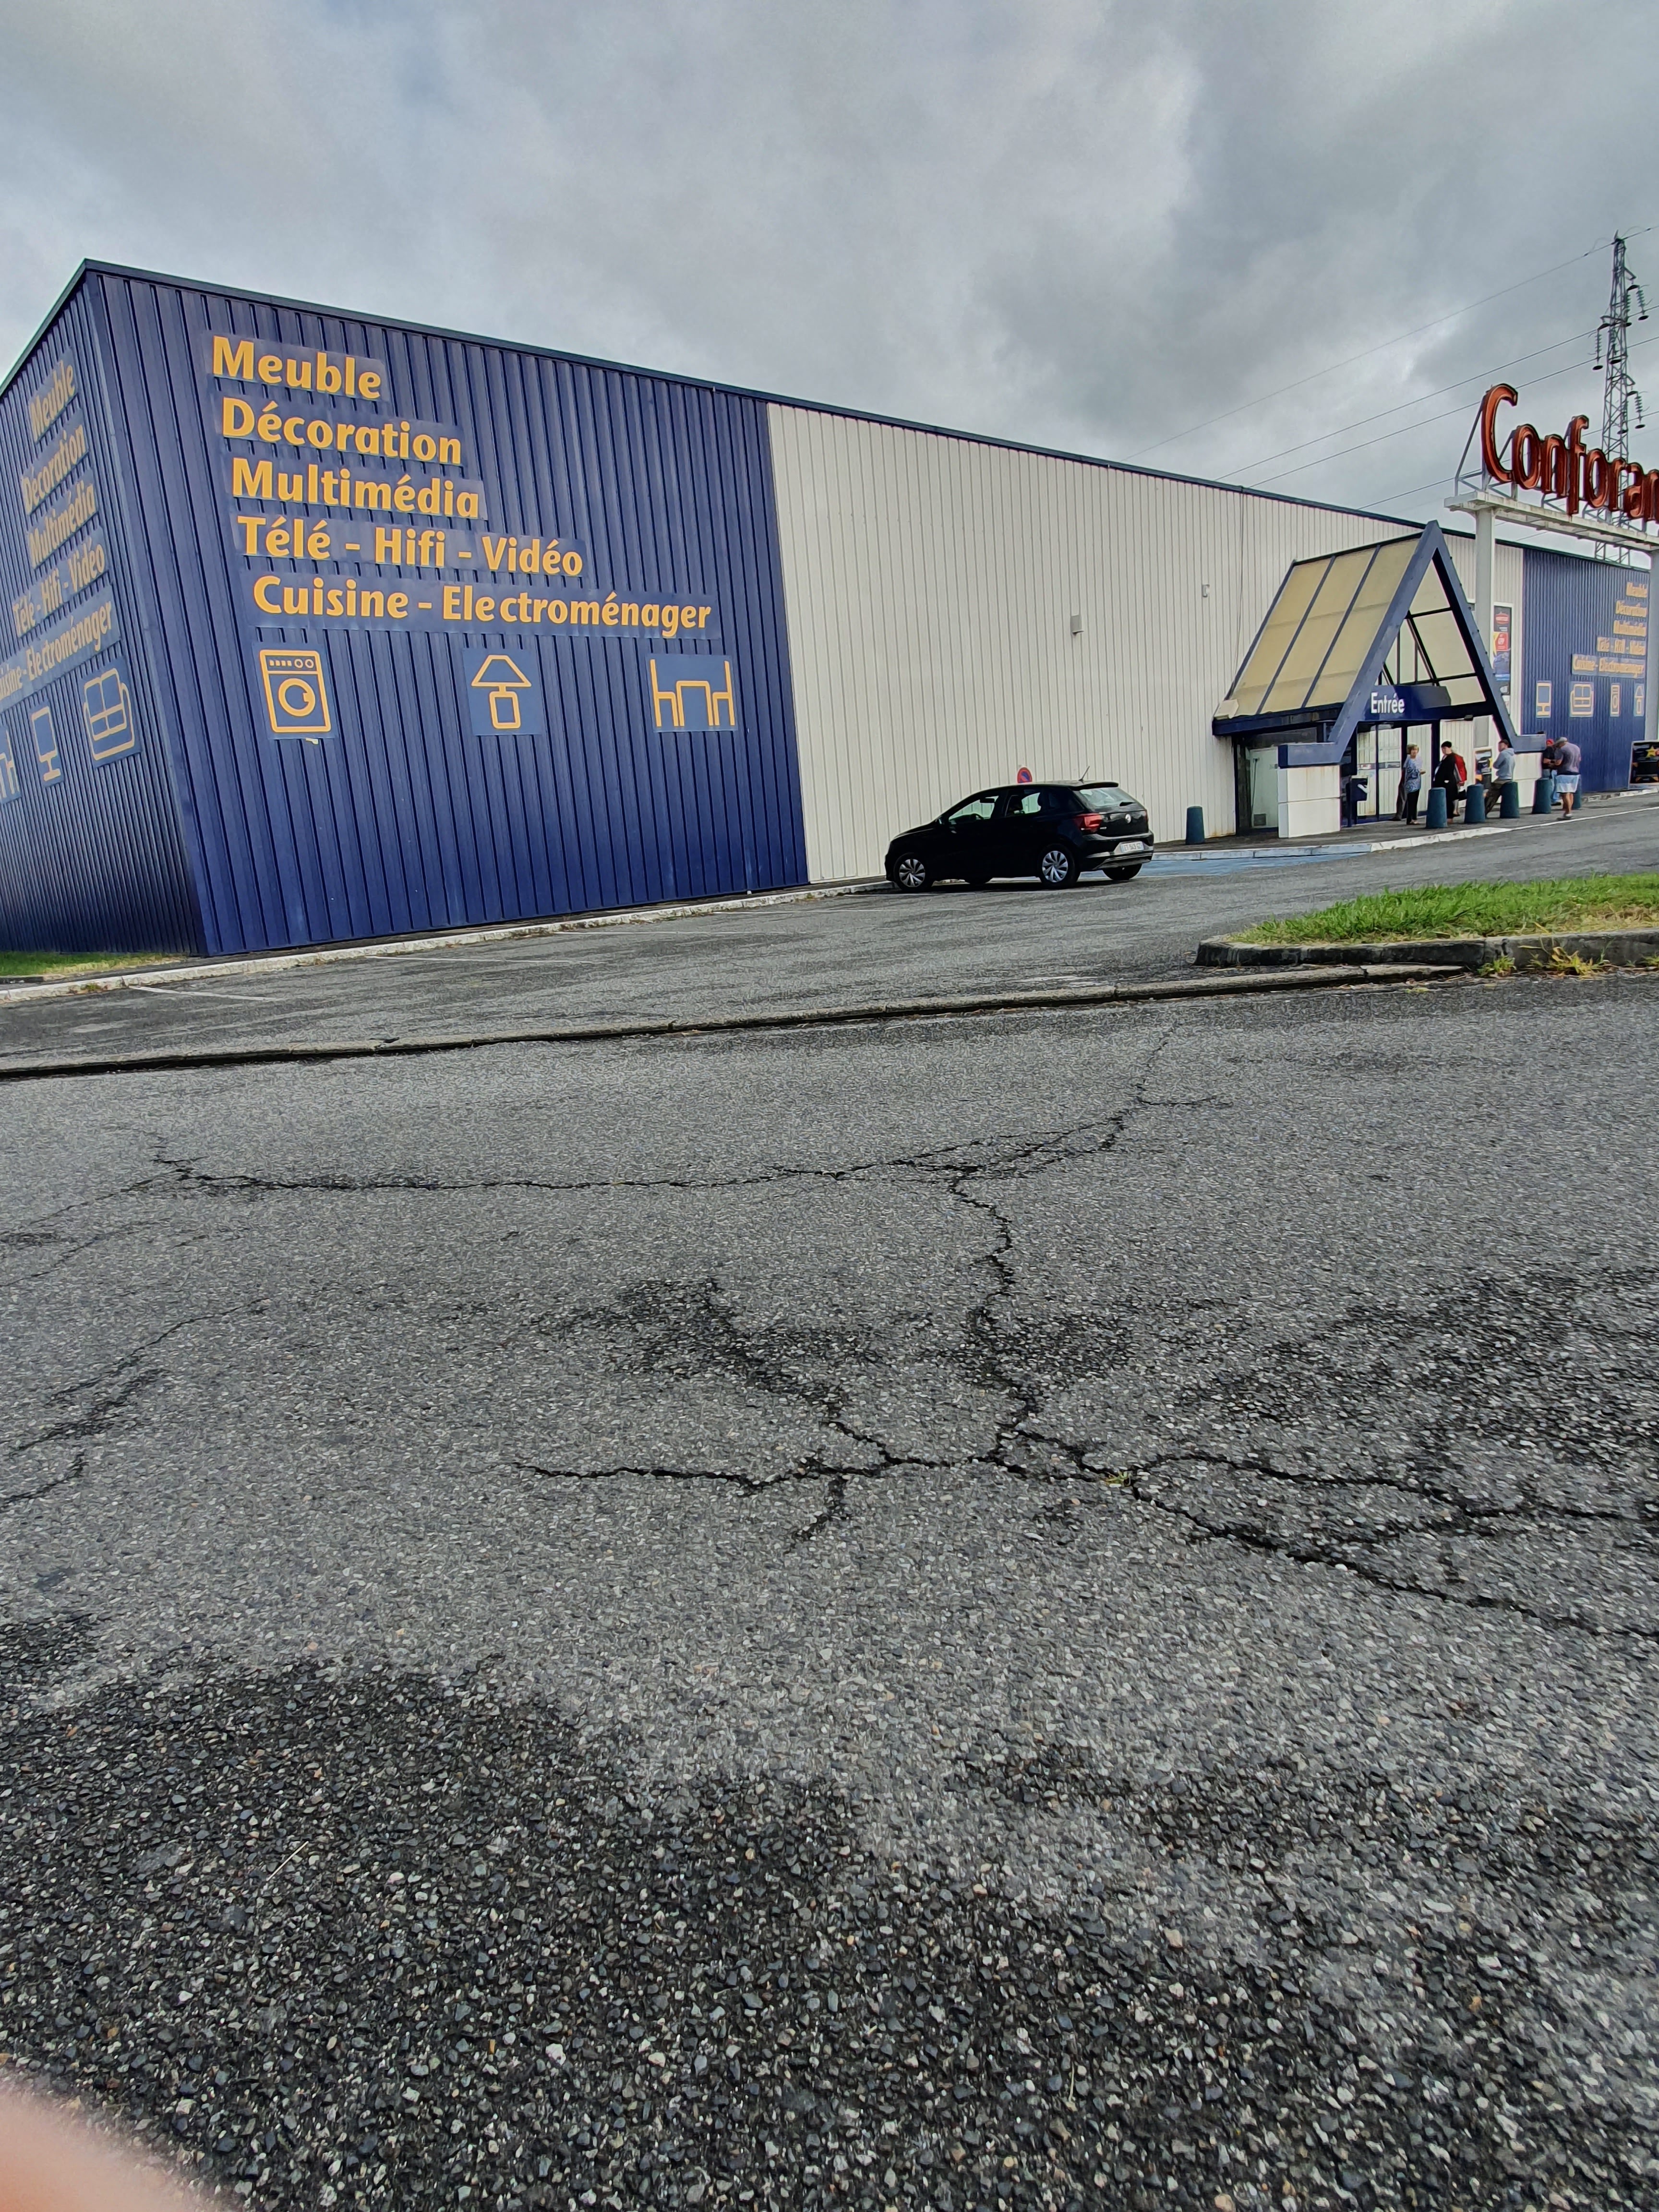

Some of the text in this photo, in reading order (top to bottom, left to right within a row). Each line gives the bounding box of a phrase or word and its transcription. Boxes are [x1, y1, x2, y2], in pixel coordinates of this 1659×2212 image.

[213, 336, 381, 399] Meuble
[31, 360, 75, 443] Meuble
[222, 397, 461, 465] Décoration
[232, 457, 479, 518] Multimédia
[68, 537, 105, 592] Vidéo
[237, 516, 330, 560] Télé
[374, 527, 445, 567] Hifi
[481, 536, 582, 576] Vidéo
[253, 575, 409, 619] Cuisine
[442, 585, 711, 637] Electroménager
[1370, 692, 1406, 714] Entrée
